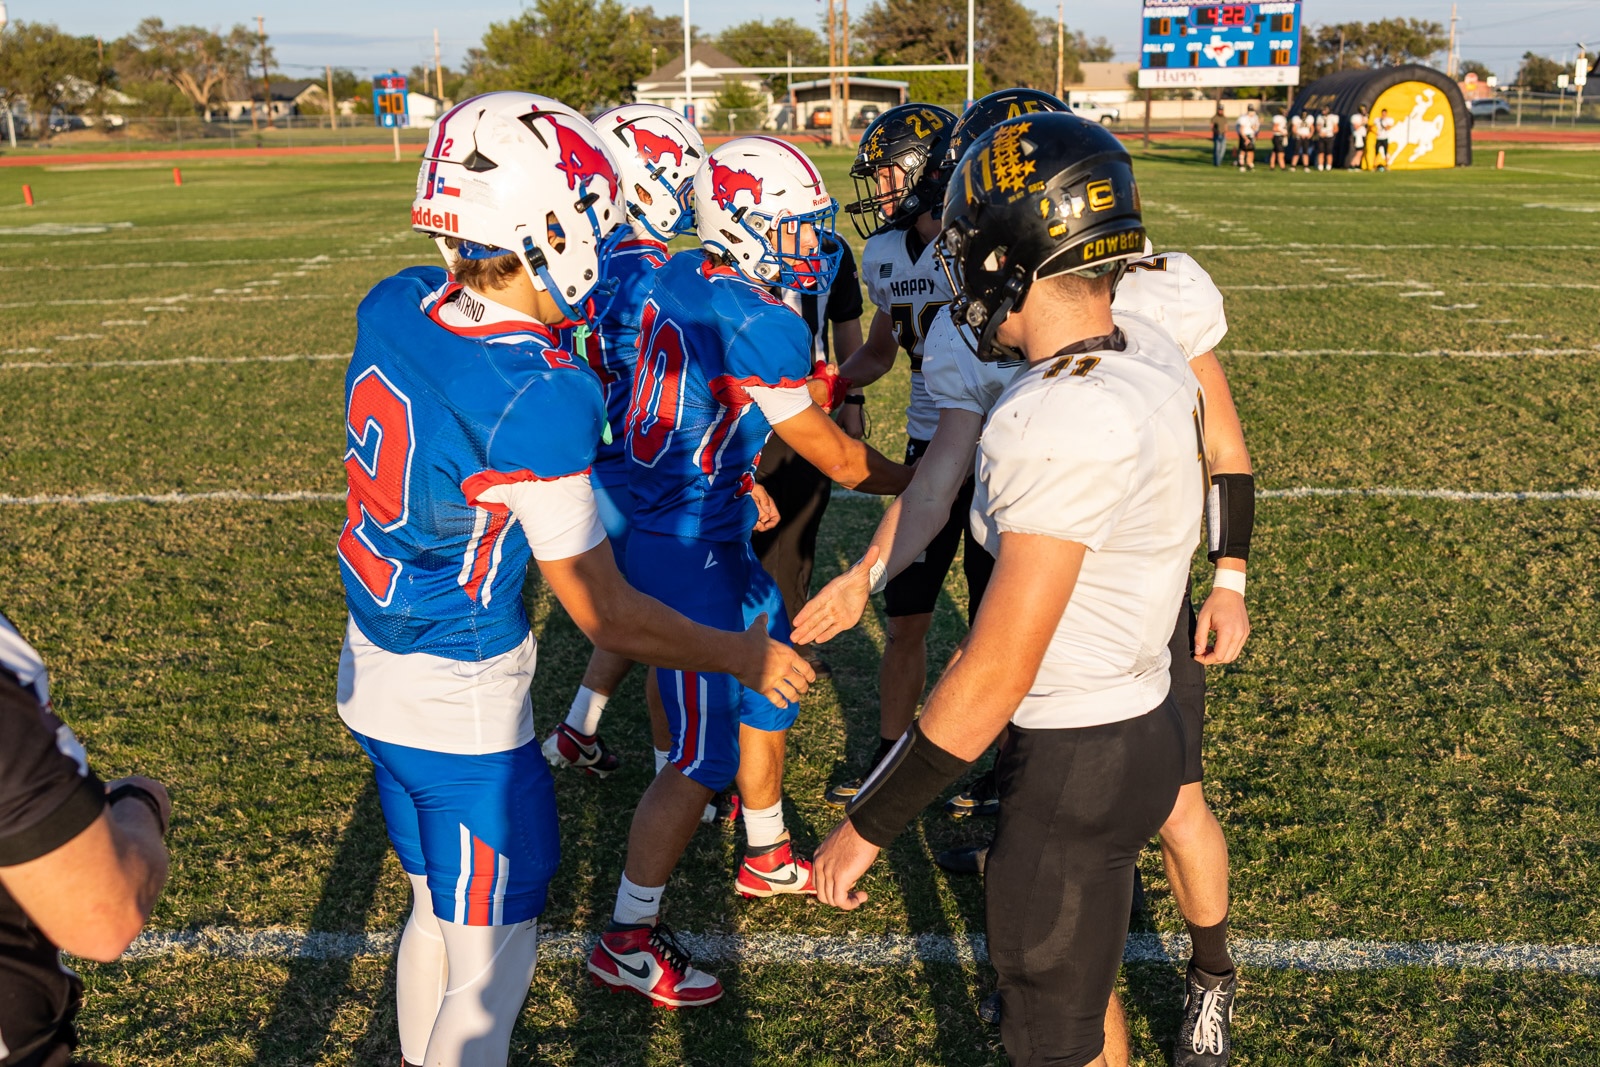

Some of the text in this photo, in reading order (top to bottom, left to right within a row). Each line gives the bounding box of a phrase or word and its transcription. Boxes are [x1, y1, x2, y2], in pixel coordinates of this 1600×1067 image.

[1160, 17, 1171, 36] 0
[1207, 6, 1246, 26] 4:22
[1281, 14, 1294, 32] 0
[1275, 49, 1290, 65] 10
[378, 93, 405, 115] 40
[905, 108, 944, 140] 29
[441, 138, 454, 157] 2
[961, 147, 993, 205] 11
[1083, 232, 1140, 261] COWBOY
[890, 278, 935, 297] HAPPY
[1042, 355, 1101, 380] 11
[336, 364, 416, 608] 2
